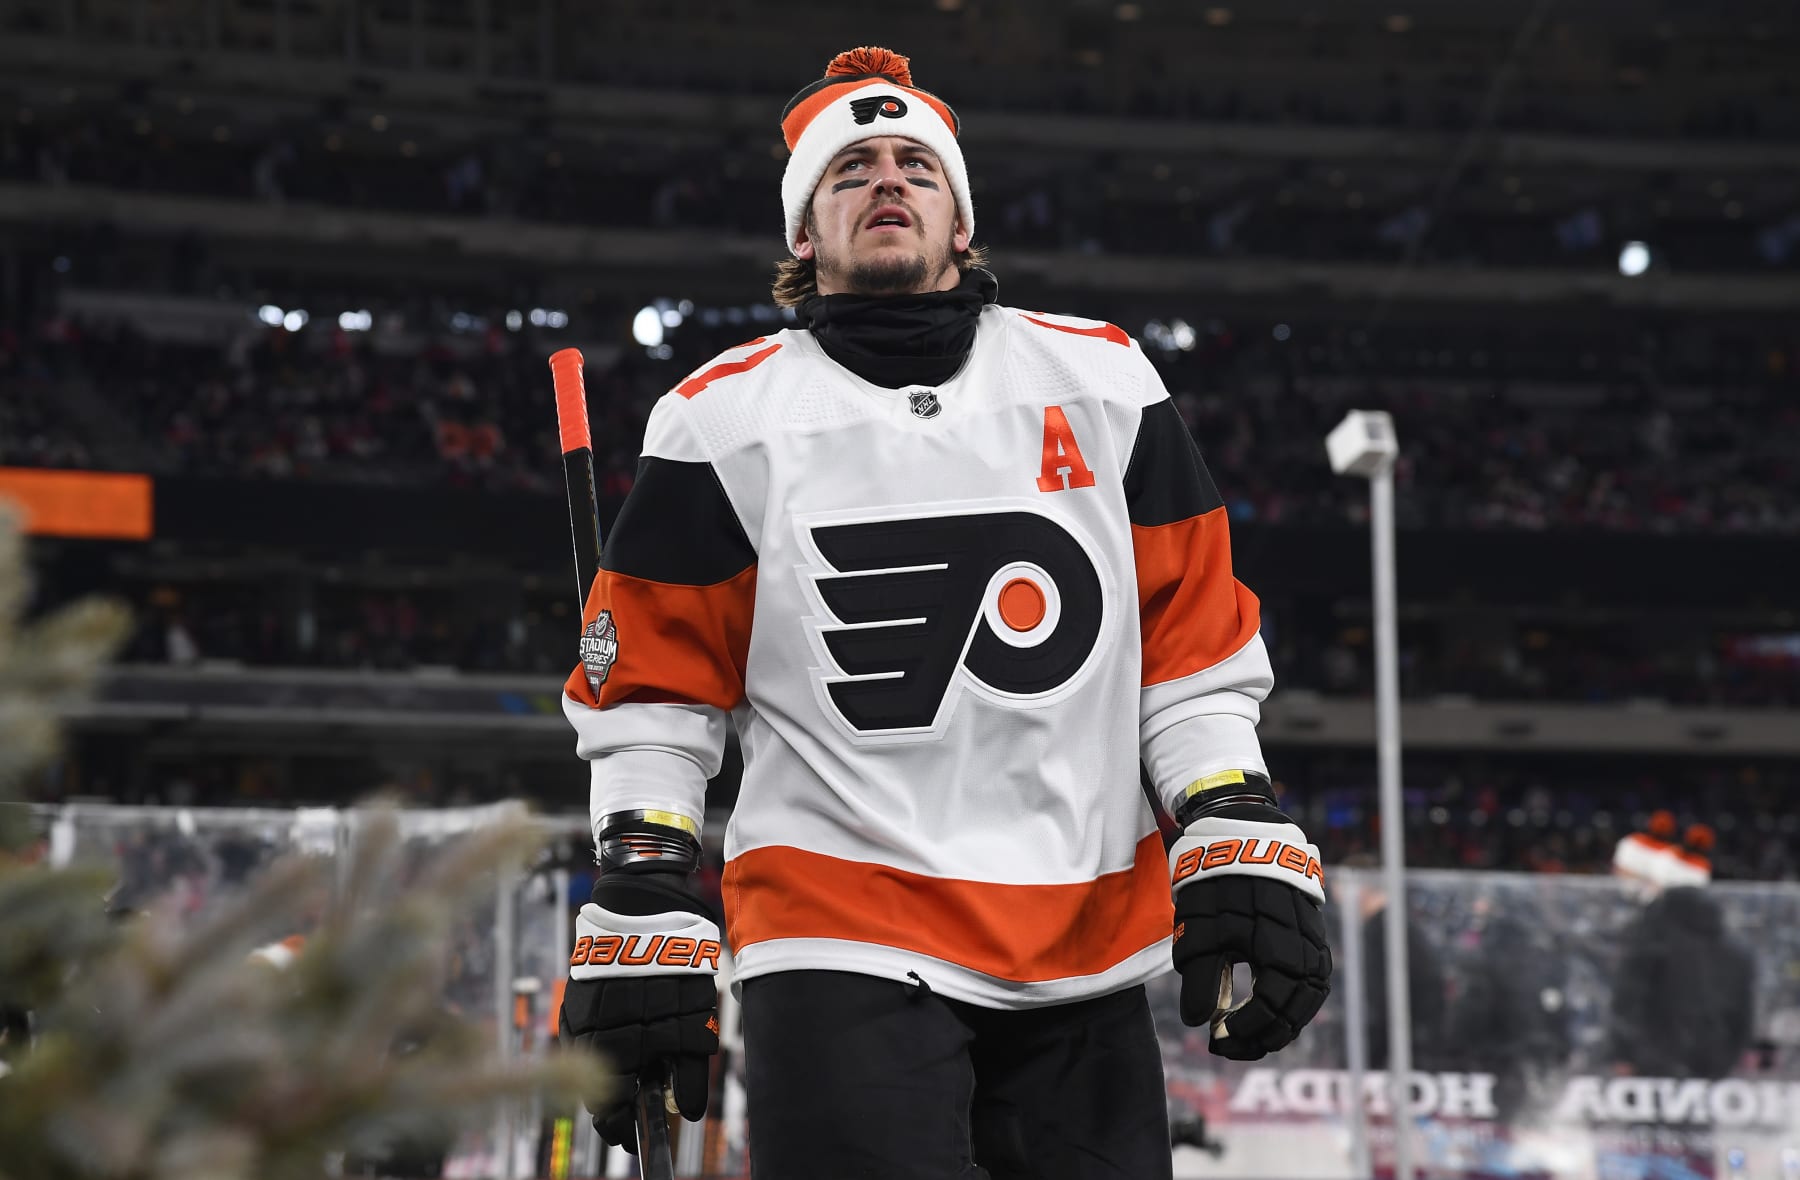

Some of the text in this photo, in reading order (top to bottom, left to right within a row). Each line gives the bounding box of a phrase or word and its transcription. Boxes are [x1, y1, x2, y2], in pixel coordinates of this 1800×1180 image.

[1035, 405, 1096, 493] A
[580, 637, 616, 660] STADIUM
[586, 652, 609, 665] SERIES
